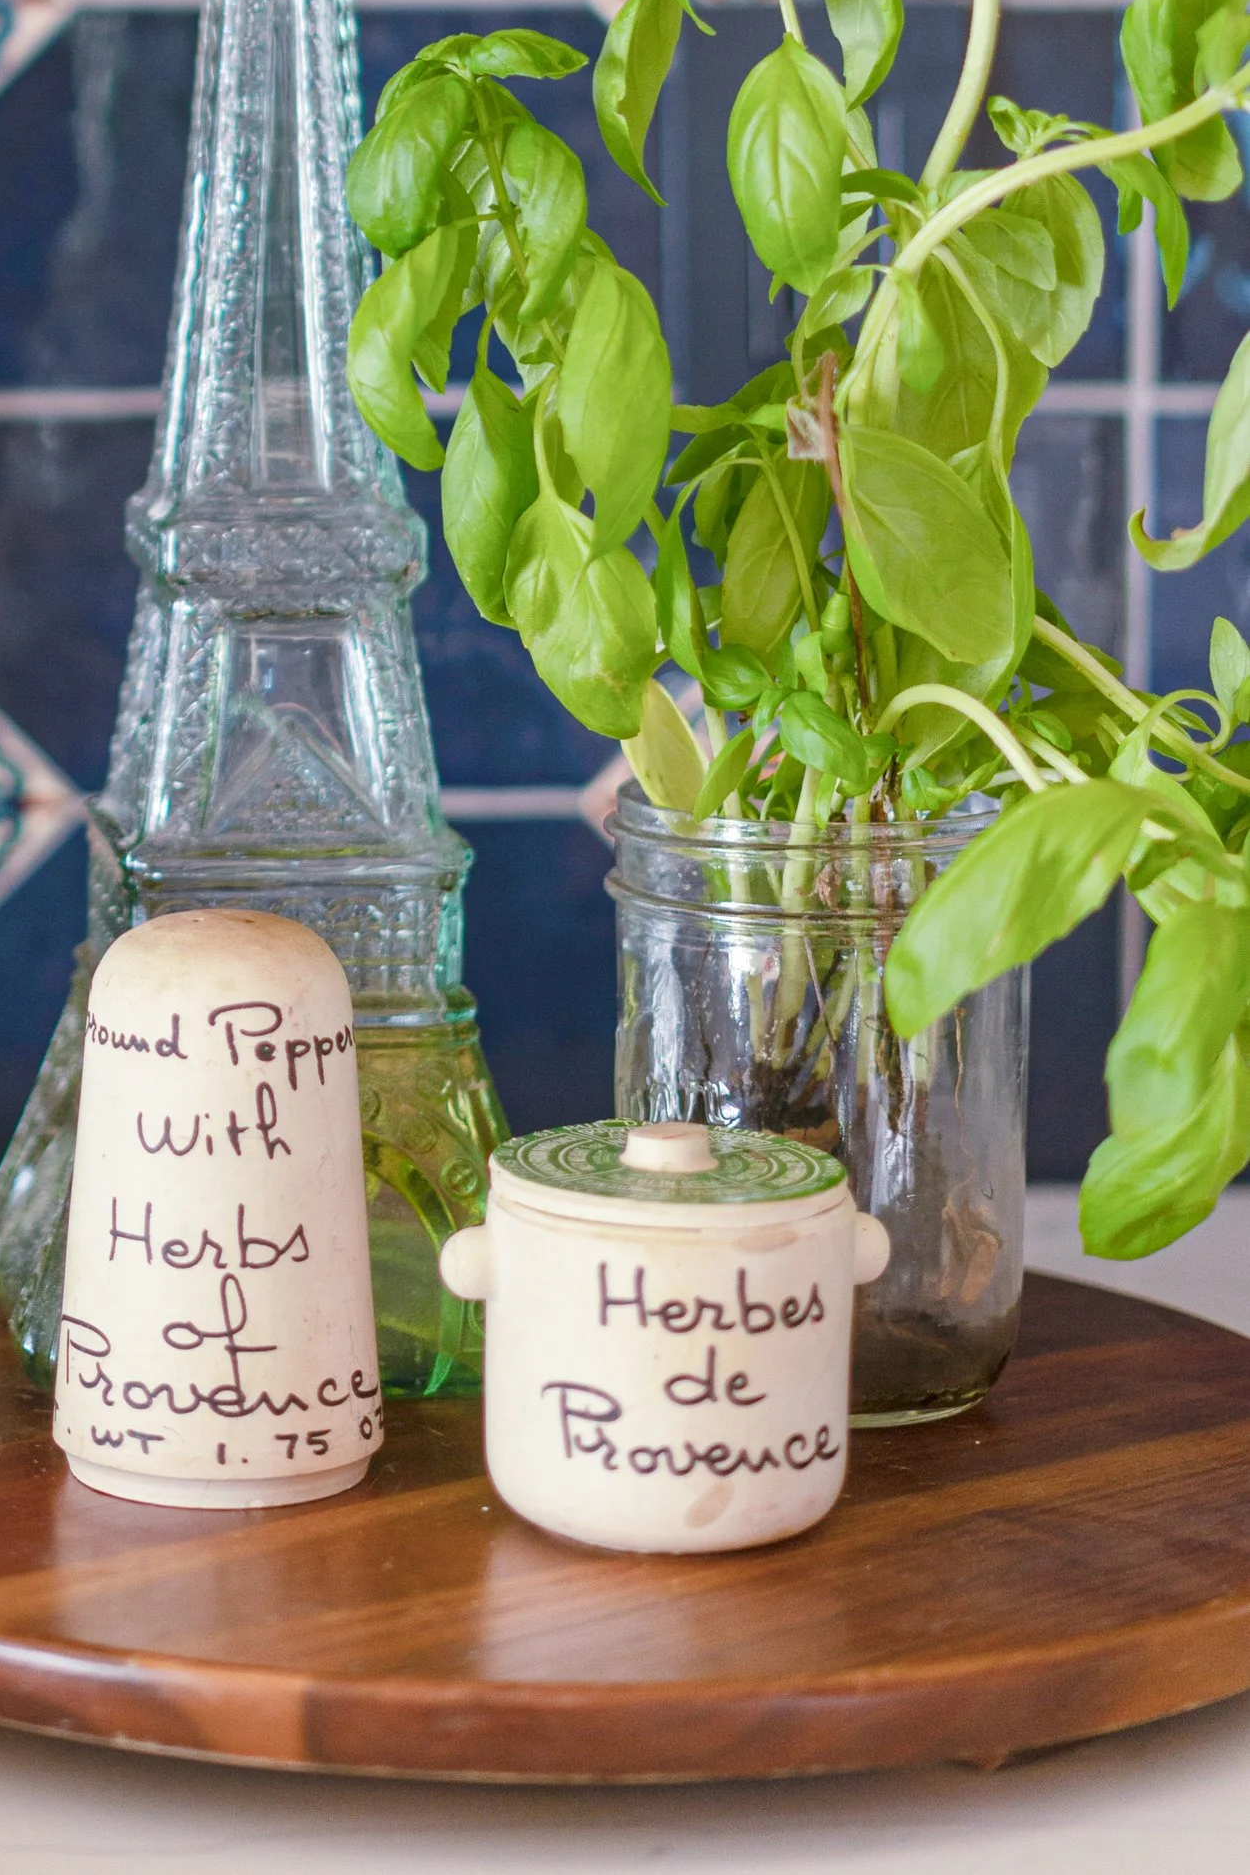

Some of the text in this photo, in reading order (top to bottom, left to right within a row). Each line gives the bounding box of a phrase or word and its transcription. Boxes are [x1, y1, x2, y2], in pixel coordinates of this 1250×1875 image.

[85, 1011, 188, 1060] round
[137, 1082, 290, 1159] With
[108, 1197, 310, 1270] Herbs
[162, 1273, 277, 1397] of
[598, 1261, 825, 1334] Herbes
[61, 1314, 378, 1418] Provence
[663, 1345, 767, 1406] de
[541, 1381, 840, 1476] Provence
